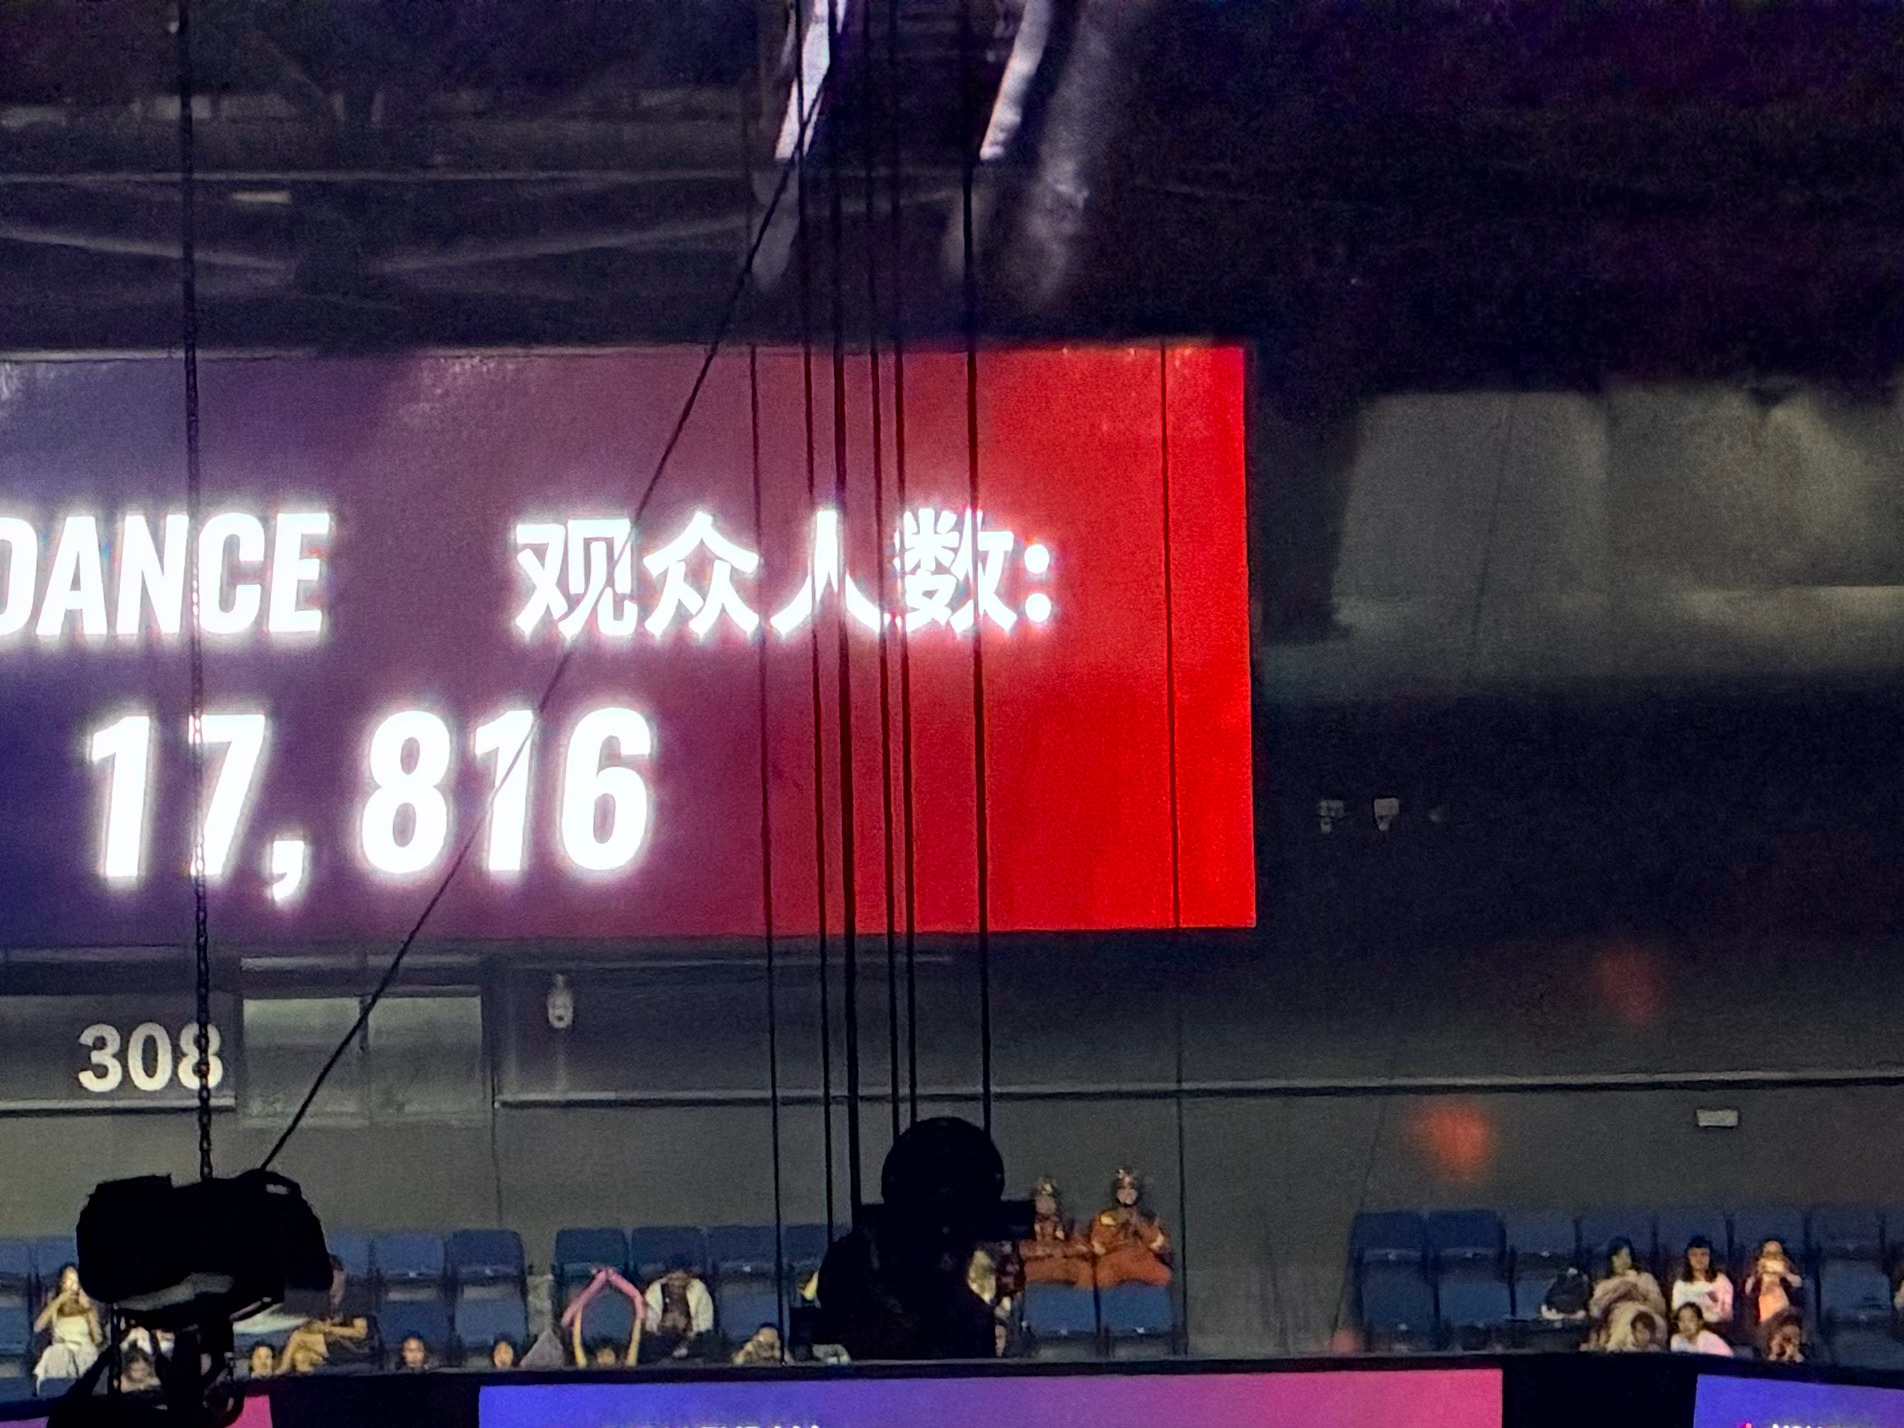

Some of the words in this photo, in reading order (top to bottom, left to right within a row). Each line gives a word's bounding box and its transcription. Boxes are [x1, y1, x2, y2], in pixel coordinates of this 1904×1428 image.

[514, 508, 1053, 640] 观众人数:
[78, 1022, 223, 1092] 308
